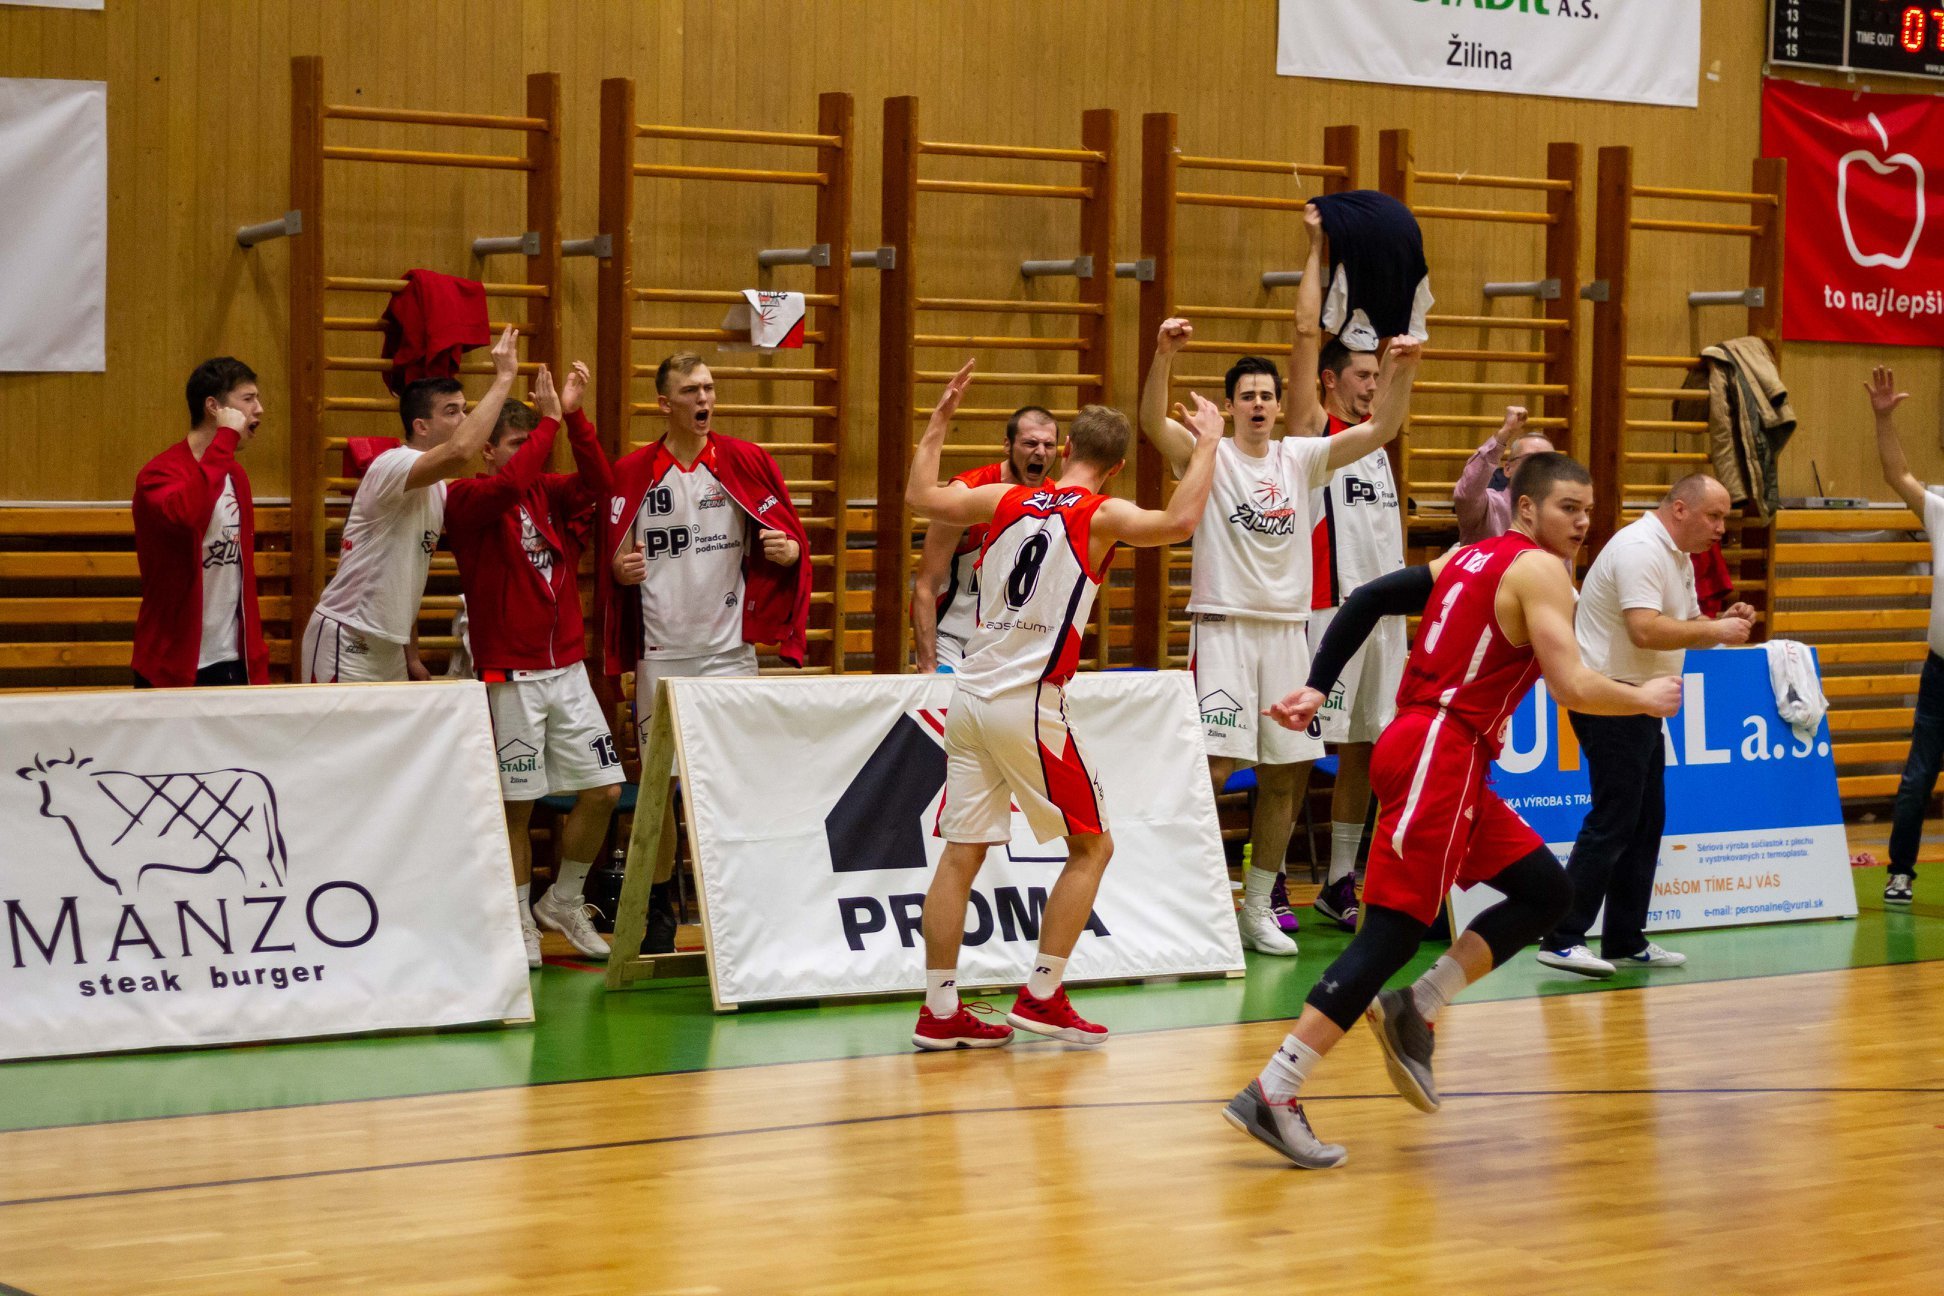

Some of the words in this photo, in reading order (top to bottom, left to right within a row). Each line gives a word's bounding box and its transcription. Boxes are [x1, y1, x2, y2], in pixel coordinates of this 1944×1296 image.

[1786, 8, 1799, 23] 13
[1786, 26, 1799, 40] 14
[1856, 30, 1876, 45] TIME
[1876, 33, 1895, 47] OUT
[1447, 33, 1512, 70] Žilina
[1785, 43, 1798, 57] 15
[1824, 284, 1846, 309] to
[647, 485, 675, 517] 19
[644, 524, 692, 561] PP
[695, 534, 728, 544] Poradca
[1004, 528, 1052, 612] 8
[1424, 581, 1464, 655] 3
[589, 733, 622, 770] 13
[1523, 794, 1564, 808] VÝROBA
[1565, 794, 1573, 806] S
[1654, 877, 1701, 897] NAŠOM
[1704, 874, 1734, 893] TÍME
[1736, 876, 1752, 891] AJ
[1755, 870, 1781, 889] VÁS
[1666, 909, 1681, 920] 170
[79, 970, 182, 996] steak
[210, 965, 325, 989] burger
